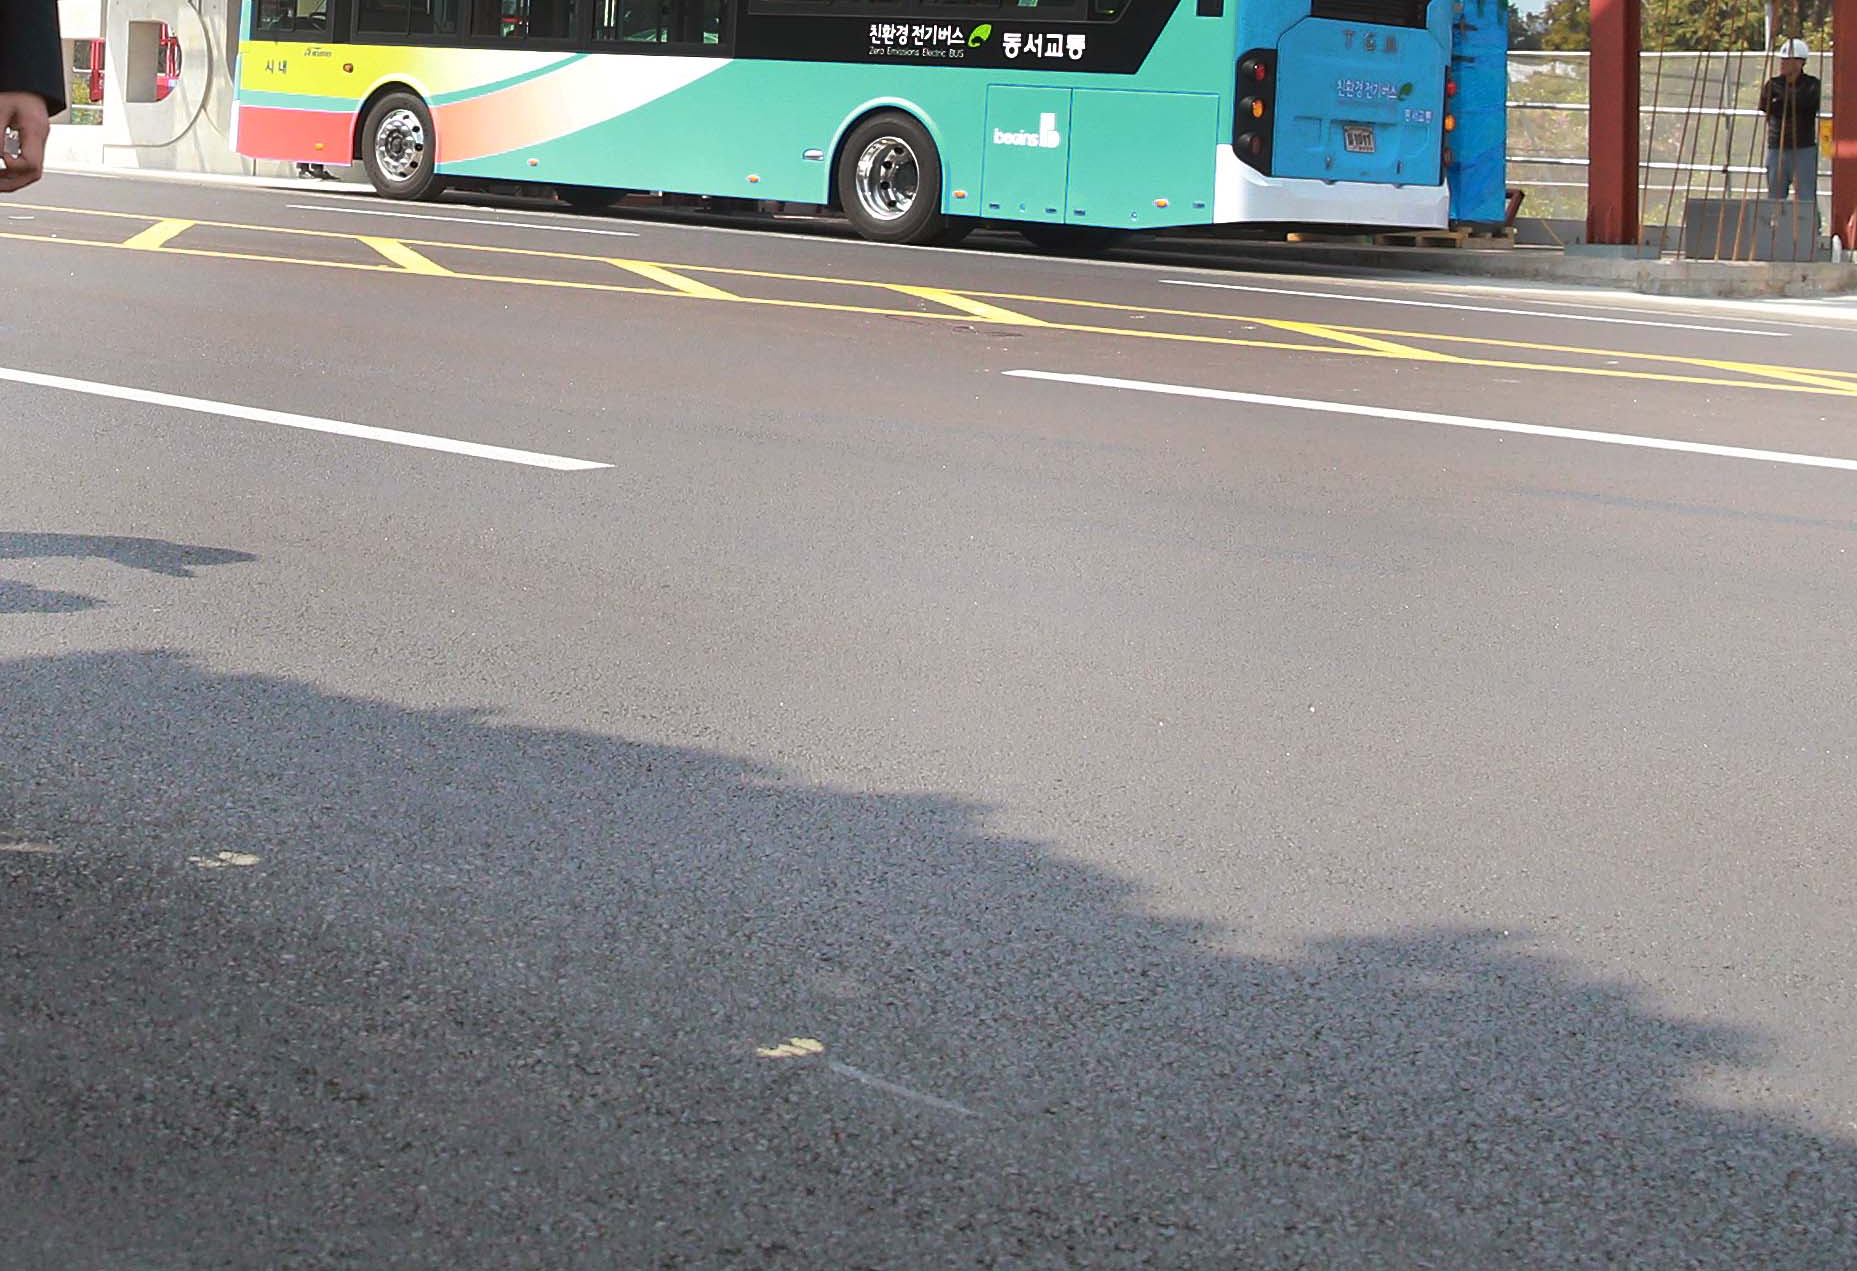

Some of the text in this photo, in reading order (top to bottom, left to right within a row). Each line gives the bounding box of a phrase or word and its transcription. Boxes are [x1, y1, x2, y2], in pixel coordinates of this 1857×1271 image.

[869, 24, 965, 46] 친환경 전기버스
[1003, 32, 1086, 60] 동서교통
[948, 48, 964, 58] BUS
